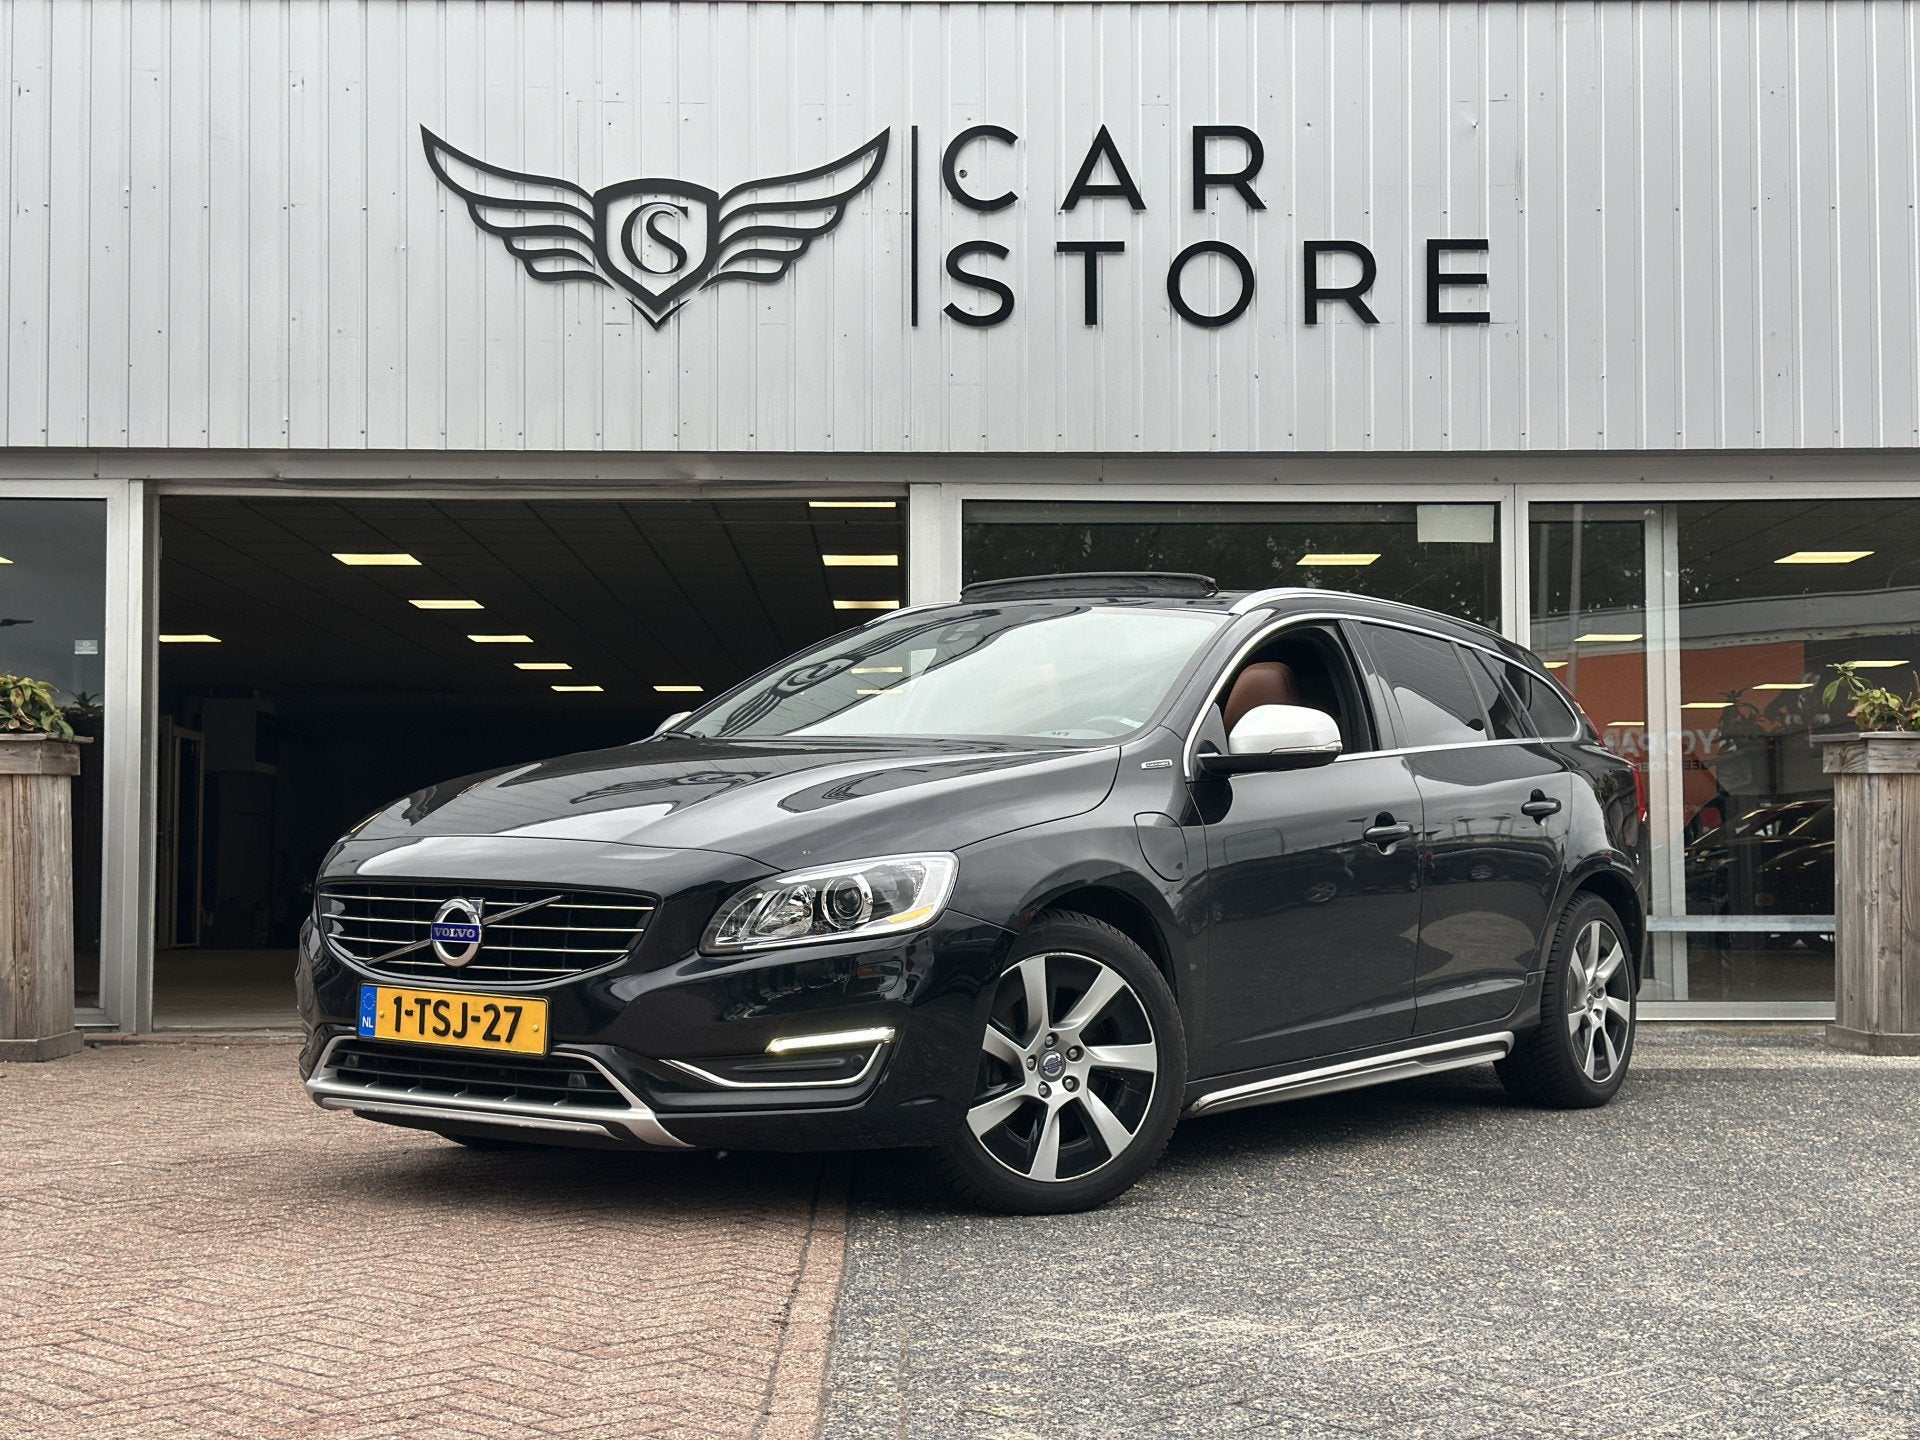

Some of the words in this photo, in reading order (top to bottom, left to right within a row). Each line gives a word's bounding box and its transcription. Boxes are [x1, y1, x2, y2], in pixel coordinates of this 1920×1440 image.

[942, 124, 1267, 211] CAR
[943, 239, 1491, 327] STORE
[433, 926, 476, 939] VOLVO
[362, 1016, 374, 1029] NL
[393, 996, 523, 1043] 1-TSJ-27
